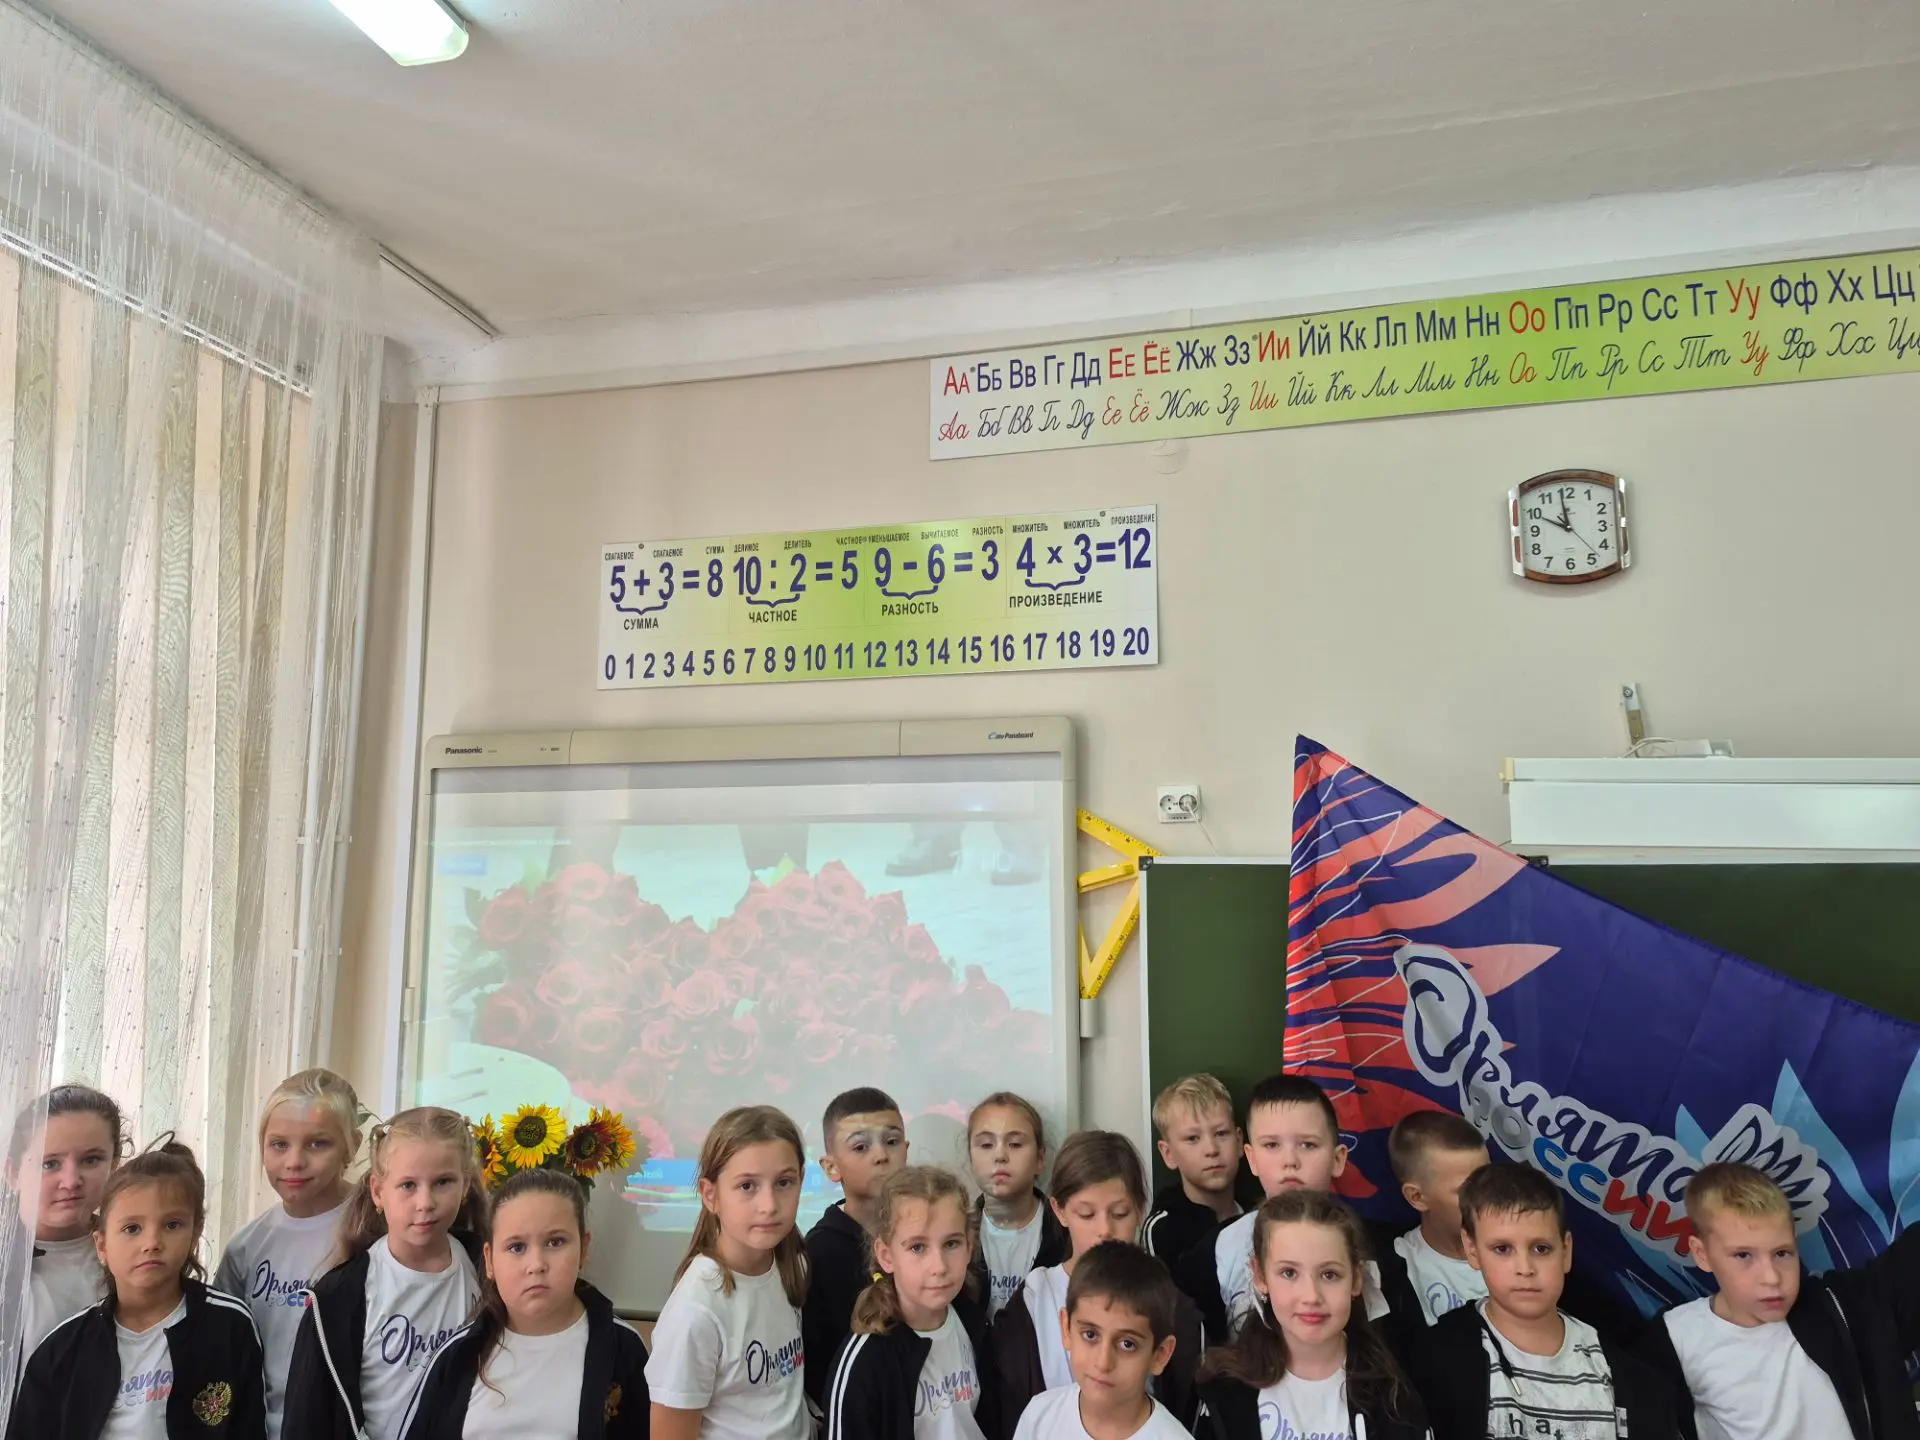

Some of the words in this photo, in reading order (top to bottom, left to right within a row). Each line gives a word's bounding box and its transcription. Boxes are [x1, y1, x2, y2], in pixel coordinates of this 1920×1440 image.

[1538, 492, 1553, 505] 11
[1557, 487, 1575, 499] 12
[1584, 489, 1592, 501] 1
[1526, 507, 1542, 520] 10
[1597, 502, 1607, 515] 2
[1012, 523, 1049, 533] МНОЖИТЕЛЬ
[1063, 518, 1101, 530] МНОЖИТЕЛЬ
[1110, 513, 1155, 525] ПРОИЗВЕДЕНИЕ
[1598, 520, 1608, 532] 3
[972, 525, 1004, 536] РАЗНОСТЬ
[1530, 525, 1541, 537] 9
[783, 539, 812, 550] ДЕЛИТЕЛЬ
[835, 535, 863, 546] ЧАСТНОЕ
[1599, 538, 1610, 550] 4
[705, 546, 725, 555] СУММА
[1531, 543, 1542, 556] 8
[1544, 556, 1554, 568] 7
[1565, 558, 1576, 570] 6
[1586, 553, 1597, 566] 5
[1009, 590, 1103, 608] ПРОИЗВЕДЕНИЕ
[881, 601, 939, 616] РАЗНОСТЬ
[748, 609, 797, 623] ЧАСТНОЕ
[623, 617, 659, 631] СУММА
[605, 654, 616, 681] 0
[625, 653, 635, 679] 1
[643, 652, 655, 679] 2
[663, 651, 675, 678] 3
[682, 650, 695, 677] 4
[703, 649, 715, 676] 5
[723, 648, 736, 675] 6
[744, 647, 756, 674] 7
[764, 646, 776, 673] 8
[784, 645, 796, 672] 9
[803, 644, 827, 671] 10
[834, 642, 853, 669] 11
[864, 640, 887, 668] 12
[894, 639, 919, 667] 13
[926, 637, 950, 665] 14
[957, 636, 983, 664] 15
[990, 634, 1015, 662] 16
[1023, 632, 1048, 661] 17
[1056, 630, 1082, 659] 18
[1089, 628, 1115, 657] 19
[1123, 626, 1150, 656] 20
[445, 746, 482, 754] Panasonic
